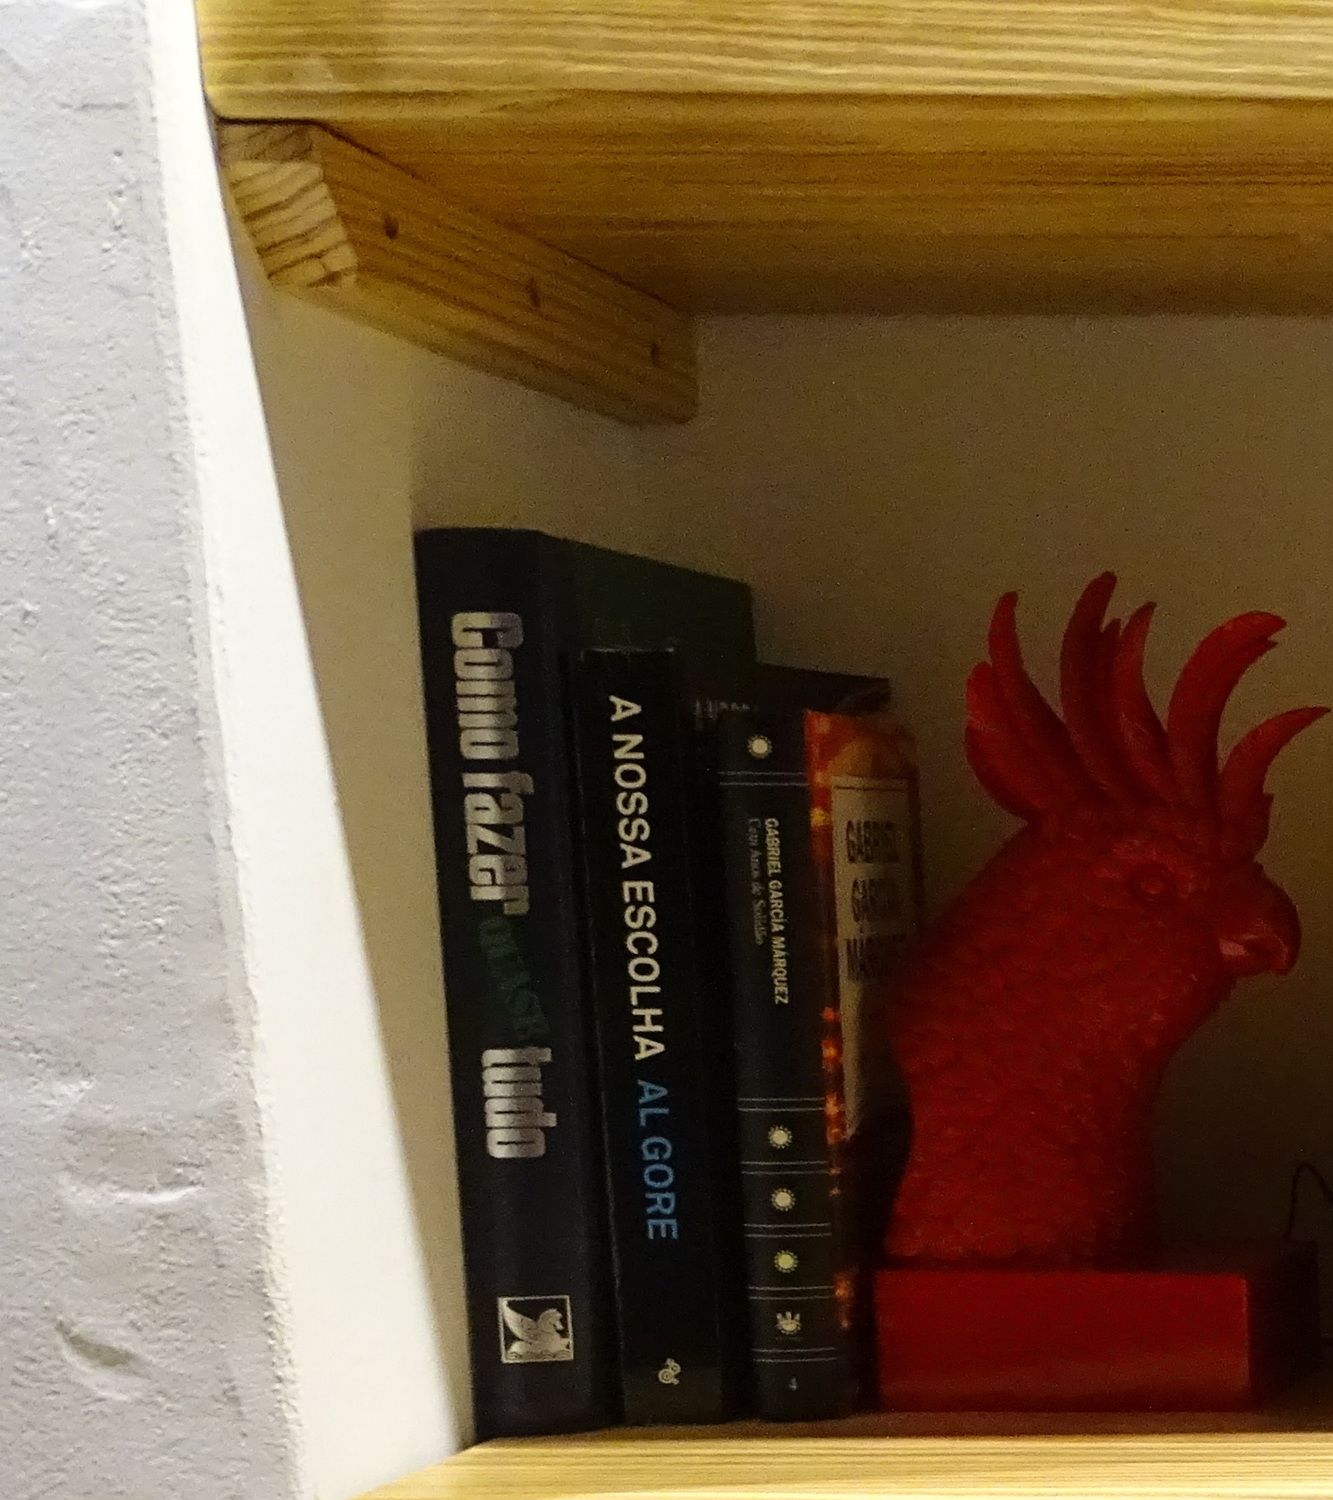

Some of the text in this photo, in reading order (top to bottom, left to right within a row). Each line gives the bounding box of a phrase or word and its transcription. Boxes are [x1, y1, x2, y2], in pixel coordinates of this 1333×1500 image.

[452, 611, 523, 760] Como
[462, 770, 533, 916] fazer
[609, 695, 668, 1061] A NOSSA ESCOLHA
[765, 818, 782, 875] GABRIEL
[482, 1046, 557, 1159] tudo
[636, 1079, 678, 1241] AL GORE
